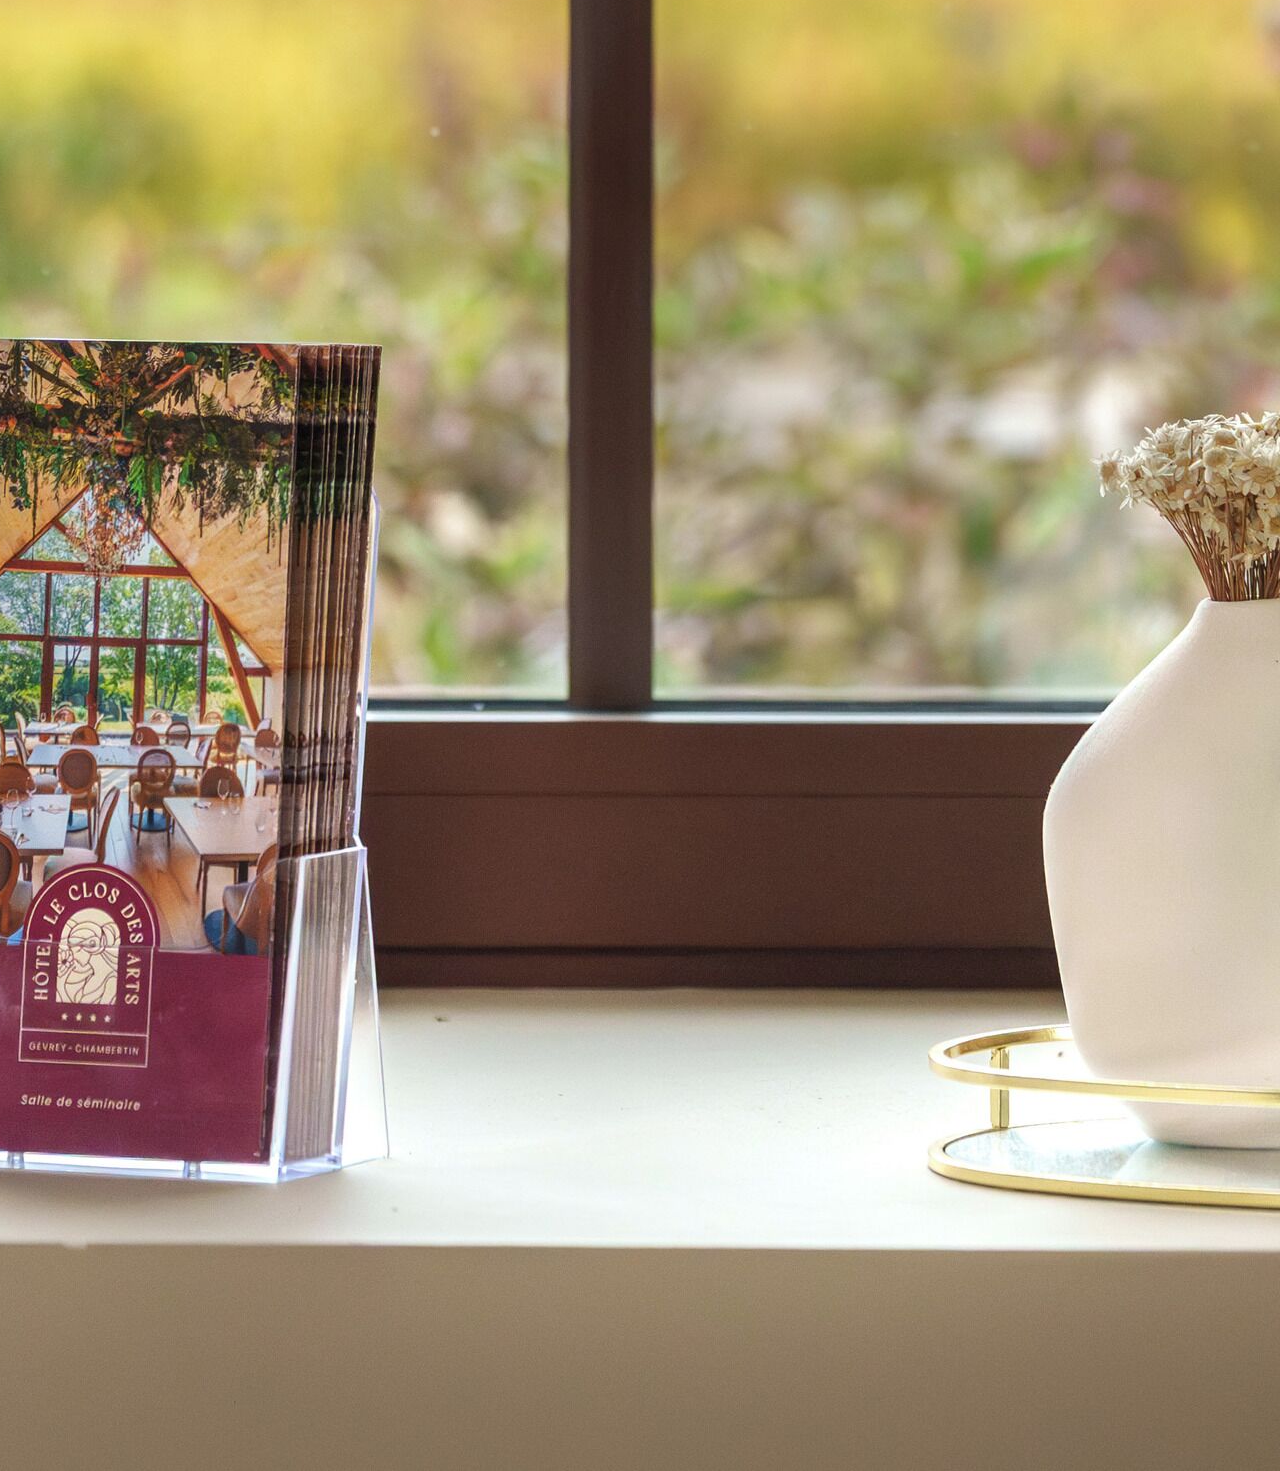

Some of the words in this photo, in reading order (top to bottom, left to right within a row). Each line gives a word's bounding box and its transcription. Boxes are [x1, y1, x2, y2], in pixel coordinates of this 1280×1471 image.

[68, 881, 120, 904] CLOS
[43, 898, 65, 925] LE
[120, 903, 144, 944] DES
[32, 933, 53, 1001] HÔTEL
[124, 952, 140, 1006] ARTS
[20, 1094, 52, 1106] Salle
[56, 1096, 72, 1107] de
[77, 1095, 141, 1111] séminaire
